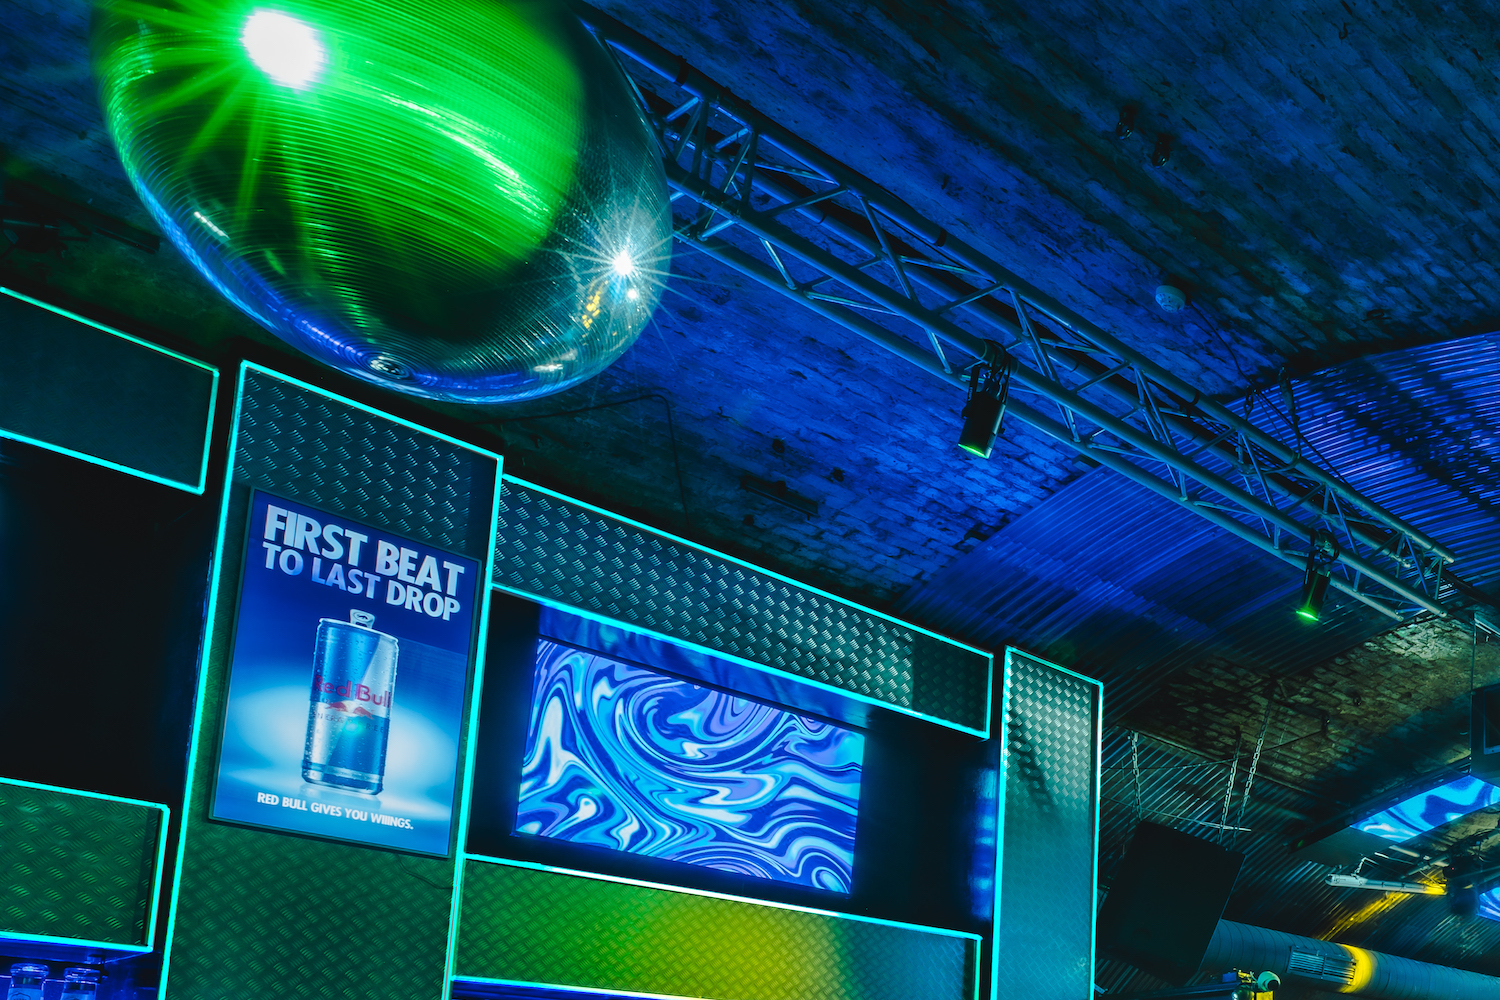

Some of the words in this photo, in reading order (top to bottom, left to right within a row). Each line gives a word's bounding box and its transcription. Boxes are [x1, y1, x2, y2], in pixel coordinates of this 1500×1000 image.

[264, 504, 368, 567] FIRST
[375, 540, 465, 597] BEAT
[262, 541, 303, 576] TO
[311, 557, 381, 599] LAST
[386, 579, 461, 621] DROP
[314, 674, 352, 698] Red
[355, 683, 391, 708] Bull
[257, 792, 279, 806] RED
[282, 796, 308, 811] BULL
[310, 802, 342, 817] GIVES
[344, 808, 368, 822] YOU
